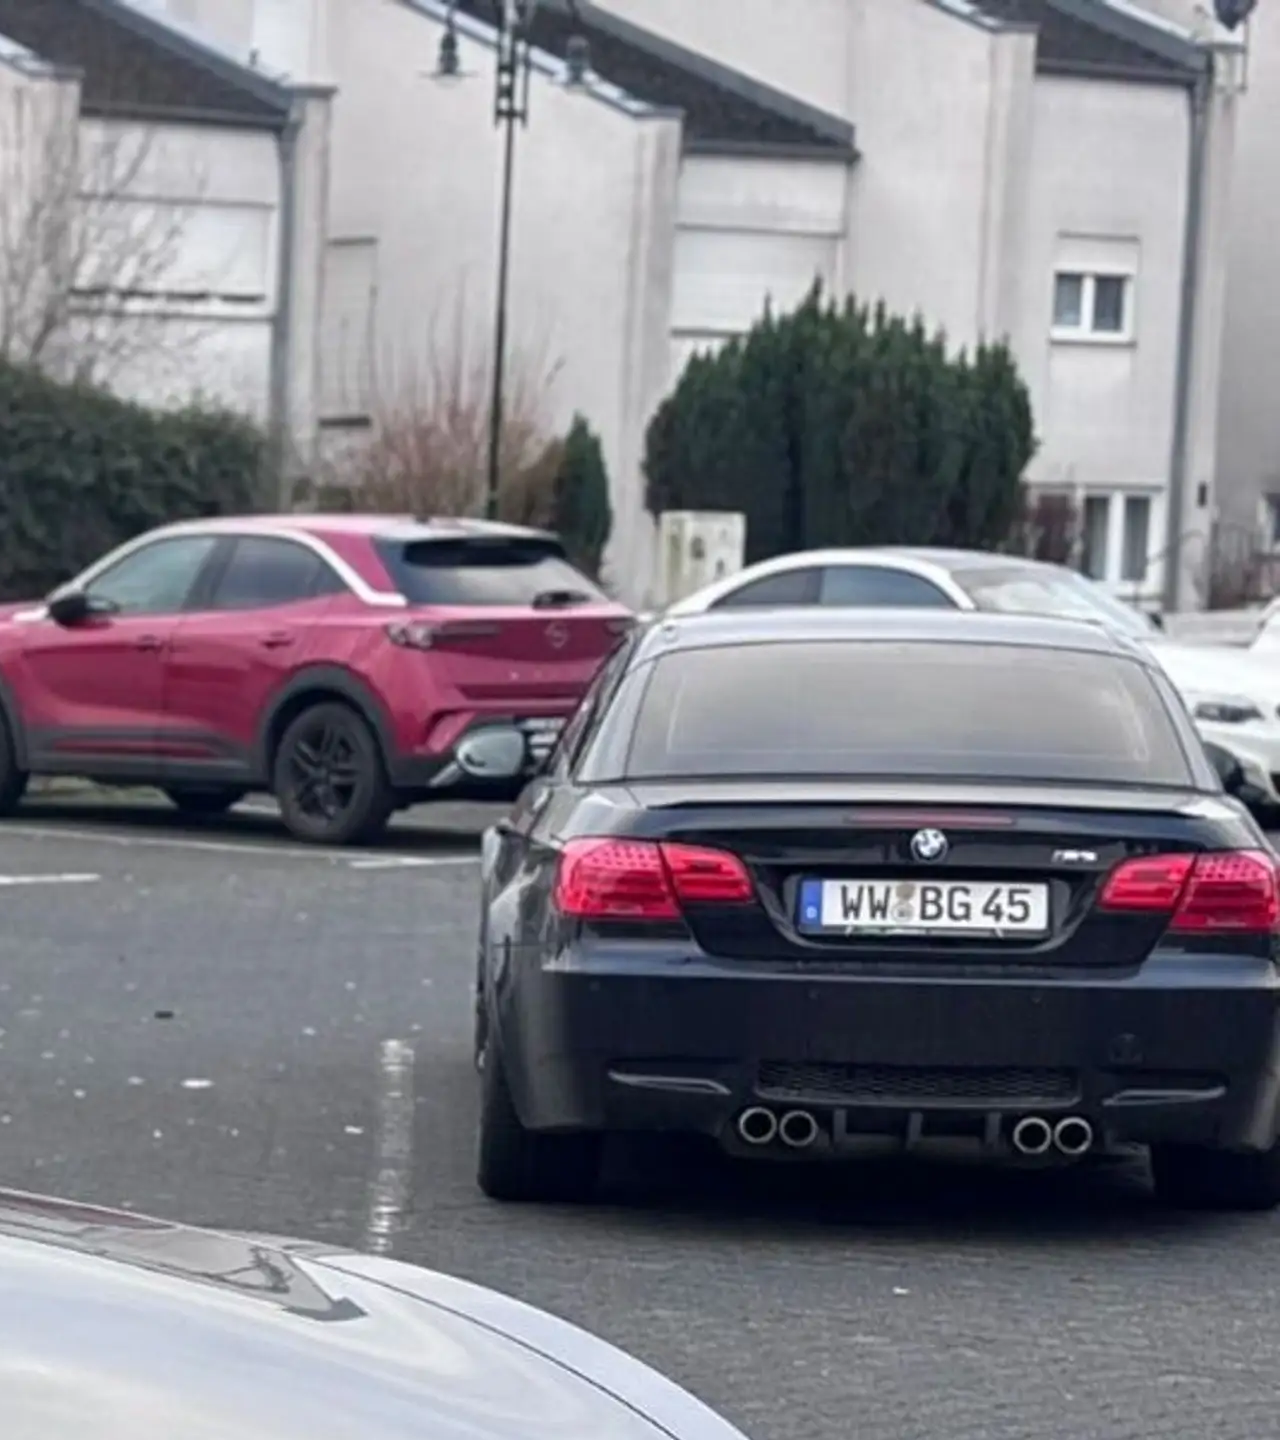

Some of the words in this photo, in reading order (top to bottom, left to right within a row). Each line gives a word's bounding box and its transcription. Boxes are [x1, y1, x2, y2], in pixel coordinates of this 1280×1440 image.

[840, 885, 891, 920] WW
[920, 886, 971, 922] BG
[982, 888, 1032, 924] 45
